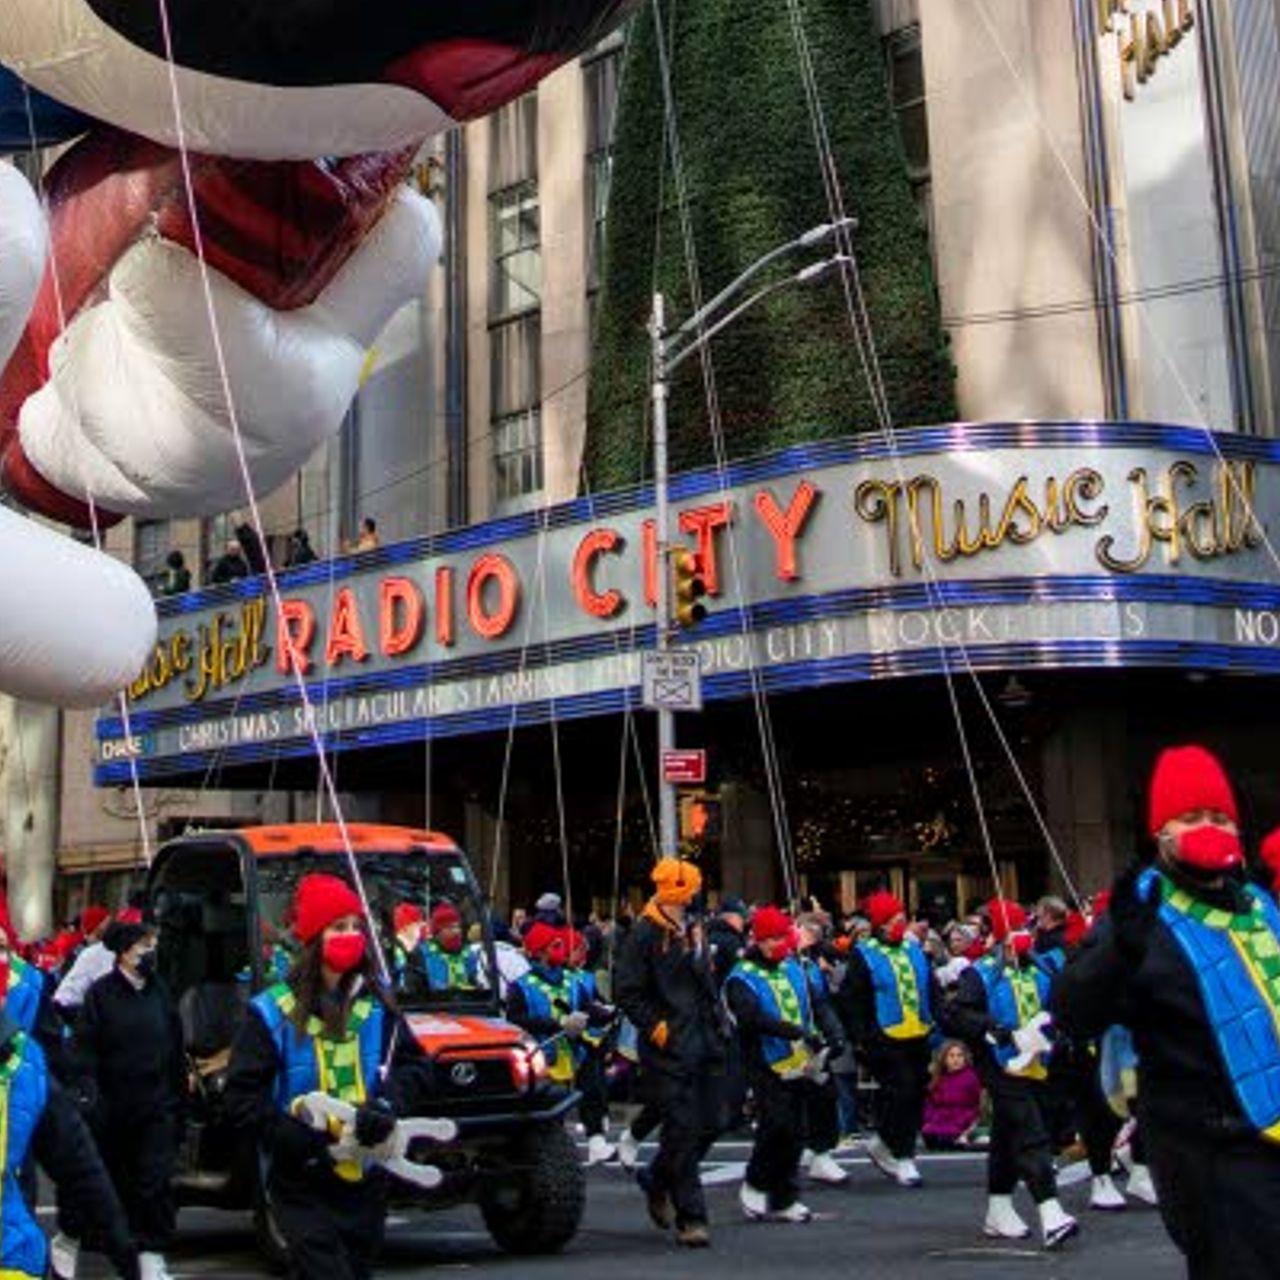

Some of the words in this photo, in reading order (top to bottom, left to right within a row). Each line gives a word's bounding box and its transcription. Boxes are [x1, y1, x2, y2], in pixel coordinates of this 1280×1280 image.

[276, 552, 519, 675] RADIO
[571, 480, 822, 618] CITY
[853, 465, 1109, 578] Music
[1095, 460, 1266, 573] Hall
[178, 710, 281, 752] CHRISTMAS
[294, 686, 441, 734] SPECTACULAR
[766, 620, 838, 663] CITY
